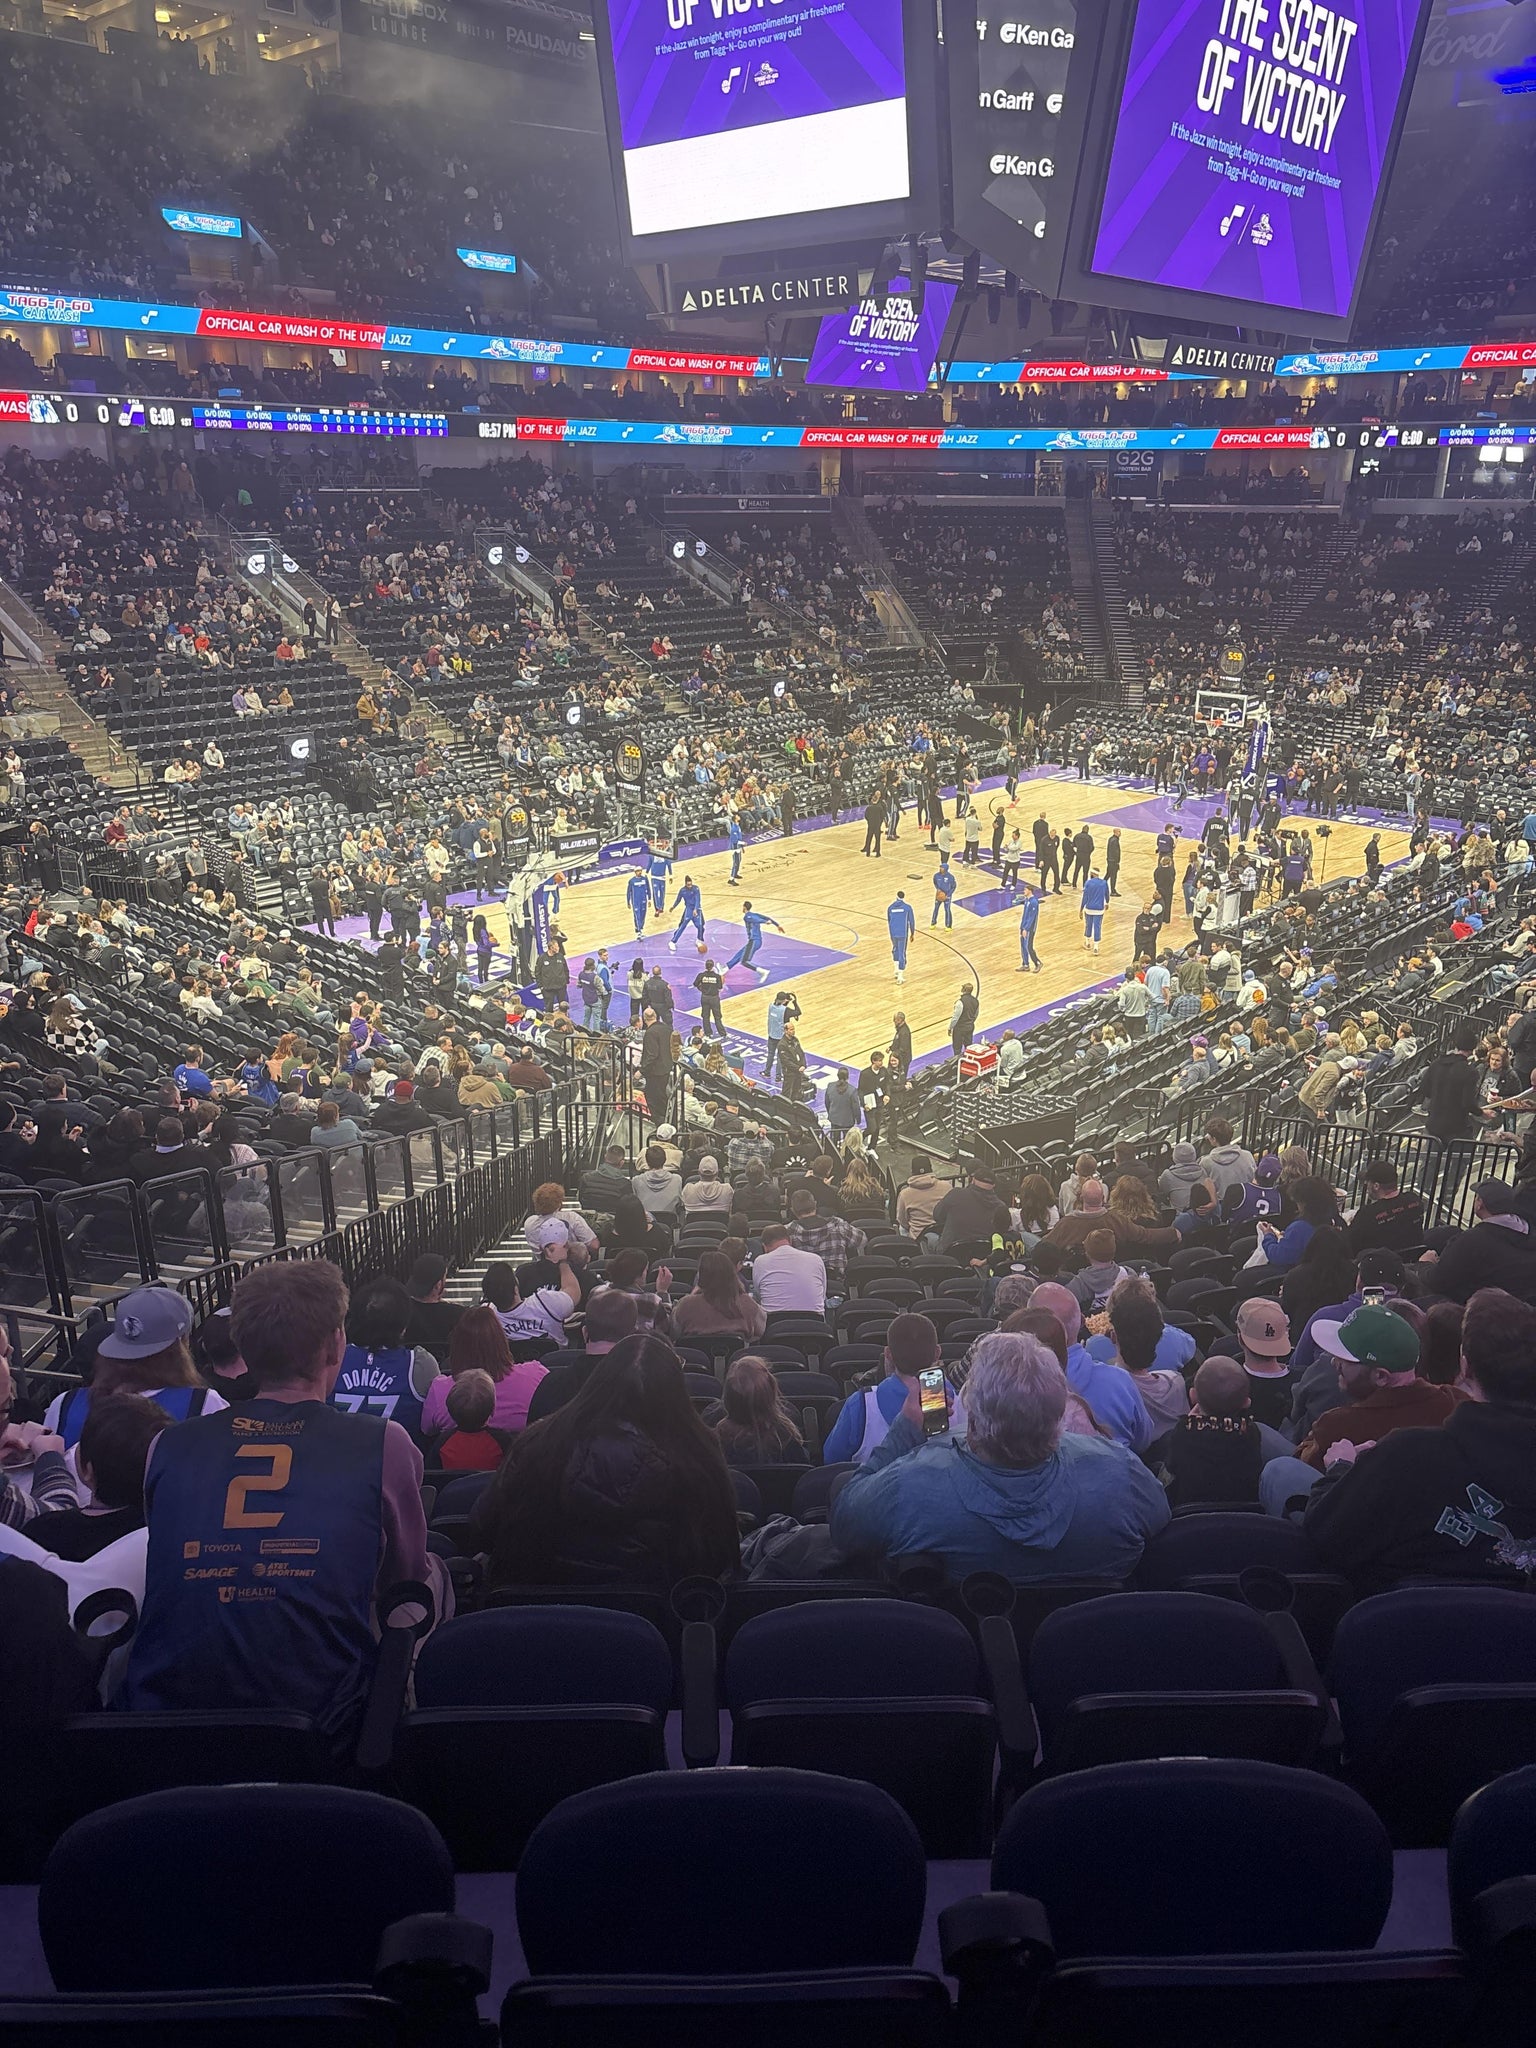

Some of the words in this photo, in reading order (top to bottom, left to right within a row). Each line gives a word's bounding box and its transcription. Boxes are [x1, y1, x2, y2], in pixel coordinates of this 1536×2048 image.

[371, 16, 428, 42] LOUNGE
[655, 46, 661, 55] If
[661, 43, 672, 53] the
[672, 40, 687, 52] Jazz
[687, 38, 699, 48] win
[699, 32, 724, 45] tonight,
[725, 28, 742, 41] enjoy
[749, 13, 799, 33] complimentary
[800, 9, 809, 20] air
[809, 2, 845, 18] freshener
[1016, 24, 1049, 46] Ken
[694, 50, 710, 60] from
[711, 40, 747, 57] Tagg-N-Go
[748, 39, 757, 48] on
[757, 35, 773, 48] your
[773, 31, 787, 43] way
[788, 26, 803, 37] out!
[1272, 0, 1358, 85] SCENT
[992, 90, 1034, 111] Garff
[1197, 39, 1241, 115] OF
[1241, 55, 1346, 154] VICTORY
[1170, 121, 1178, 137] If
[1178, 125, 1189, 141] the
[1189, 129, 1205, 147] Jazz
[1205, 135, 1218, 151] win
[1218, 138, 1242, 161] tonight,
[1242, 148, 1259, 165] enjoy
[1264, 155, 1307, 181] complimentary
[1306, 168, 1315, 181] air
[1314, 169, 1341, 189] freshener
[1005, 155, 1036, 176] Ken
[1207, 156, 1223, 173] from
[1225, 161, 1259, 184] Tagg-N-Go
[1259, 176, 1267, 186] on
[1267, 179, 1281, 193] your
[1280, 182, 1293, 197] way
[1292, 185, 1305, 198] out!
[701, 285, 765, 308] DELTA
[771, 276, 849, 301] CENTER
[7, 294, 94, 313] TAGG-N-GO
[22, 307, 46, 321] CAR
[46, 309, 81, 322] WASH
[205, 316, 256, 332] OFFICIAL
[257, 321, 282, 335] CAR
[284, 323, 318, 338] WASH
[320, 326, 336, 339] OF
[338, 328, 357, 341] THE
[359, 330, 386, 344] UTAH
[388, 333, 412, 346] JAZZ
[849, 315, 868, 337] OF
[869, 317, 920, 342] VICTORY
[509, 340, 563, 353] TAGG-N-GO
[517, 350, 533, 360] CAR
[534, 351, 555, 362] WASH
[633, 354, 667, 367] OFFICIAL
[668, 356, 686, 368] CAR
[687, 357, 714, 369] WASH
[715, 358, 728, 370] OF
[729, 360, 744, 371] THE
[746, 361, 769, 372] UTAH
[1186, 347, 1227, 368] DELTA
[1231, 352, 1275, 373] CENTER
[1315, 353, 1379, 364] TAGG-N-GO
[1471, 350, 1518, 362] OFFICIAL
[1026, 366, 1067, 378] OFFICIAL
[1069, 366, 1091, 377] CAR
[1092, 365, 1121, 376] WASH
[1324, 363, 1340, 372] CAR
[1342, 362, 1367, 371] WASH
[66, 403, 78, 422] 0
[97, 404, 109, 424] 0
[149, 407, 175, 426] 6:00
[180, 417, 192, 427] 1ST
[478, 423, 502, 438] 06:57
[503, 423, 516, 438] PM
[525, 424, 536, 434] OF
[538, 425, 552, 435] THE
[554, 425, 577, 436] UTAH
[578, 426, 597, 437] JAZZ
[680, 426, 733, 436] TAGG-N-GO
[687, 434, 702, 443] CAR
[703, 434, 724, 443] WASH
[807, 432, 845, 443] OFFICIAL
[846, 433, 865, 444] CAR
[867, 433, 894, 444] WASH
[896, 433, 909, 444] OF
[911, 434, 927, 444] THE
[929, 434, 953, 445] UTAH
[955, 434, 978, 445] JAZZ
[1078, 431, 1137, 441] TAGG-N-GO
[1221, 434, 1261, 444] OFFICIAL
[1263, 433, 1285, 443] CAR
[1336, 432, 1346, 447] 0
[1360, 431, 1369, 447] 0
[1401, 430, 1423, 446] 6:00
[1086, 439, 1102, 448] CAR
[1103, 439, 1127, 448] WASH
[1116, 450, 1154, 466] G2G
[342, 1366, 397, 1392] DONČIĆ
[334, 1392, 400, 1419] 77
[222, 1444, 293, 1530] 2
[203, 1543, 242, 1553] TOYOTA
[183, 1566, 239, 1580] SAVAGE
[266, 1569, 316, 1577] SPORTSNET
[267, 1562, 289, 1570] AT&T
[238, 1587, 277, 1597] HEALTH
